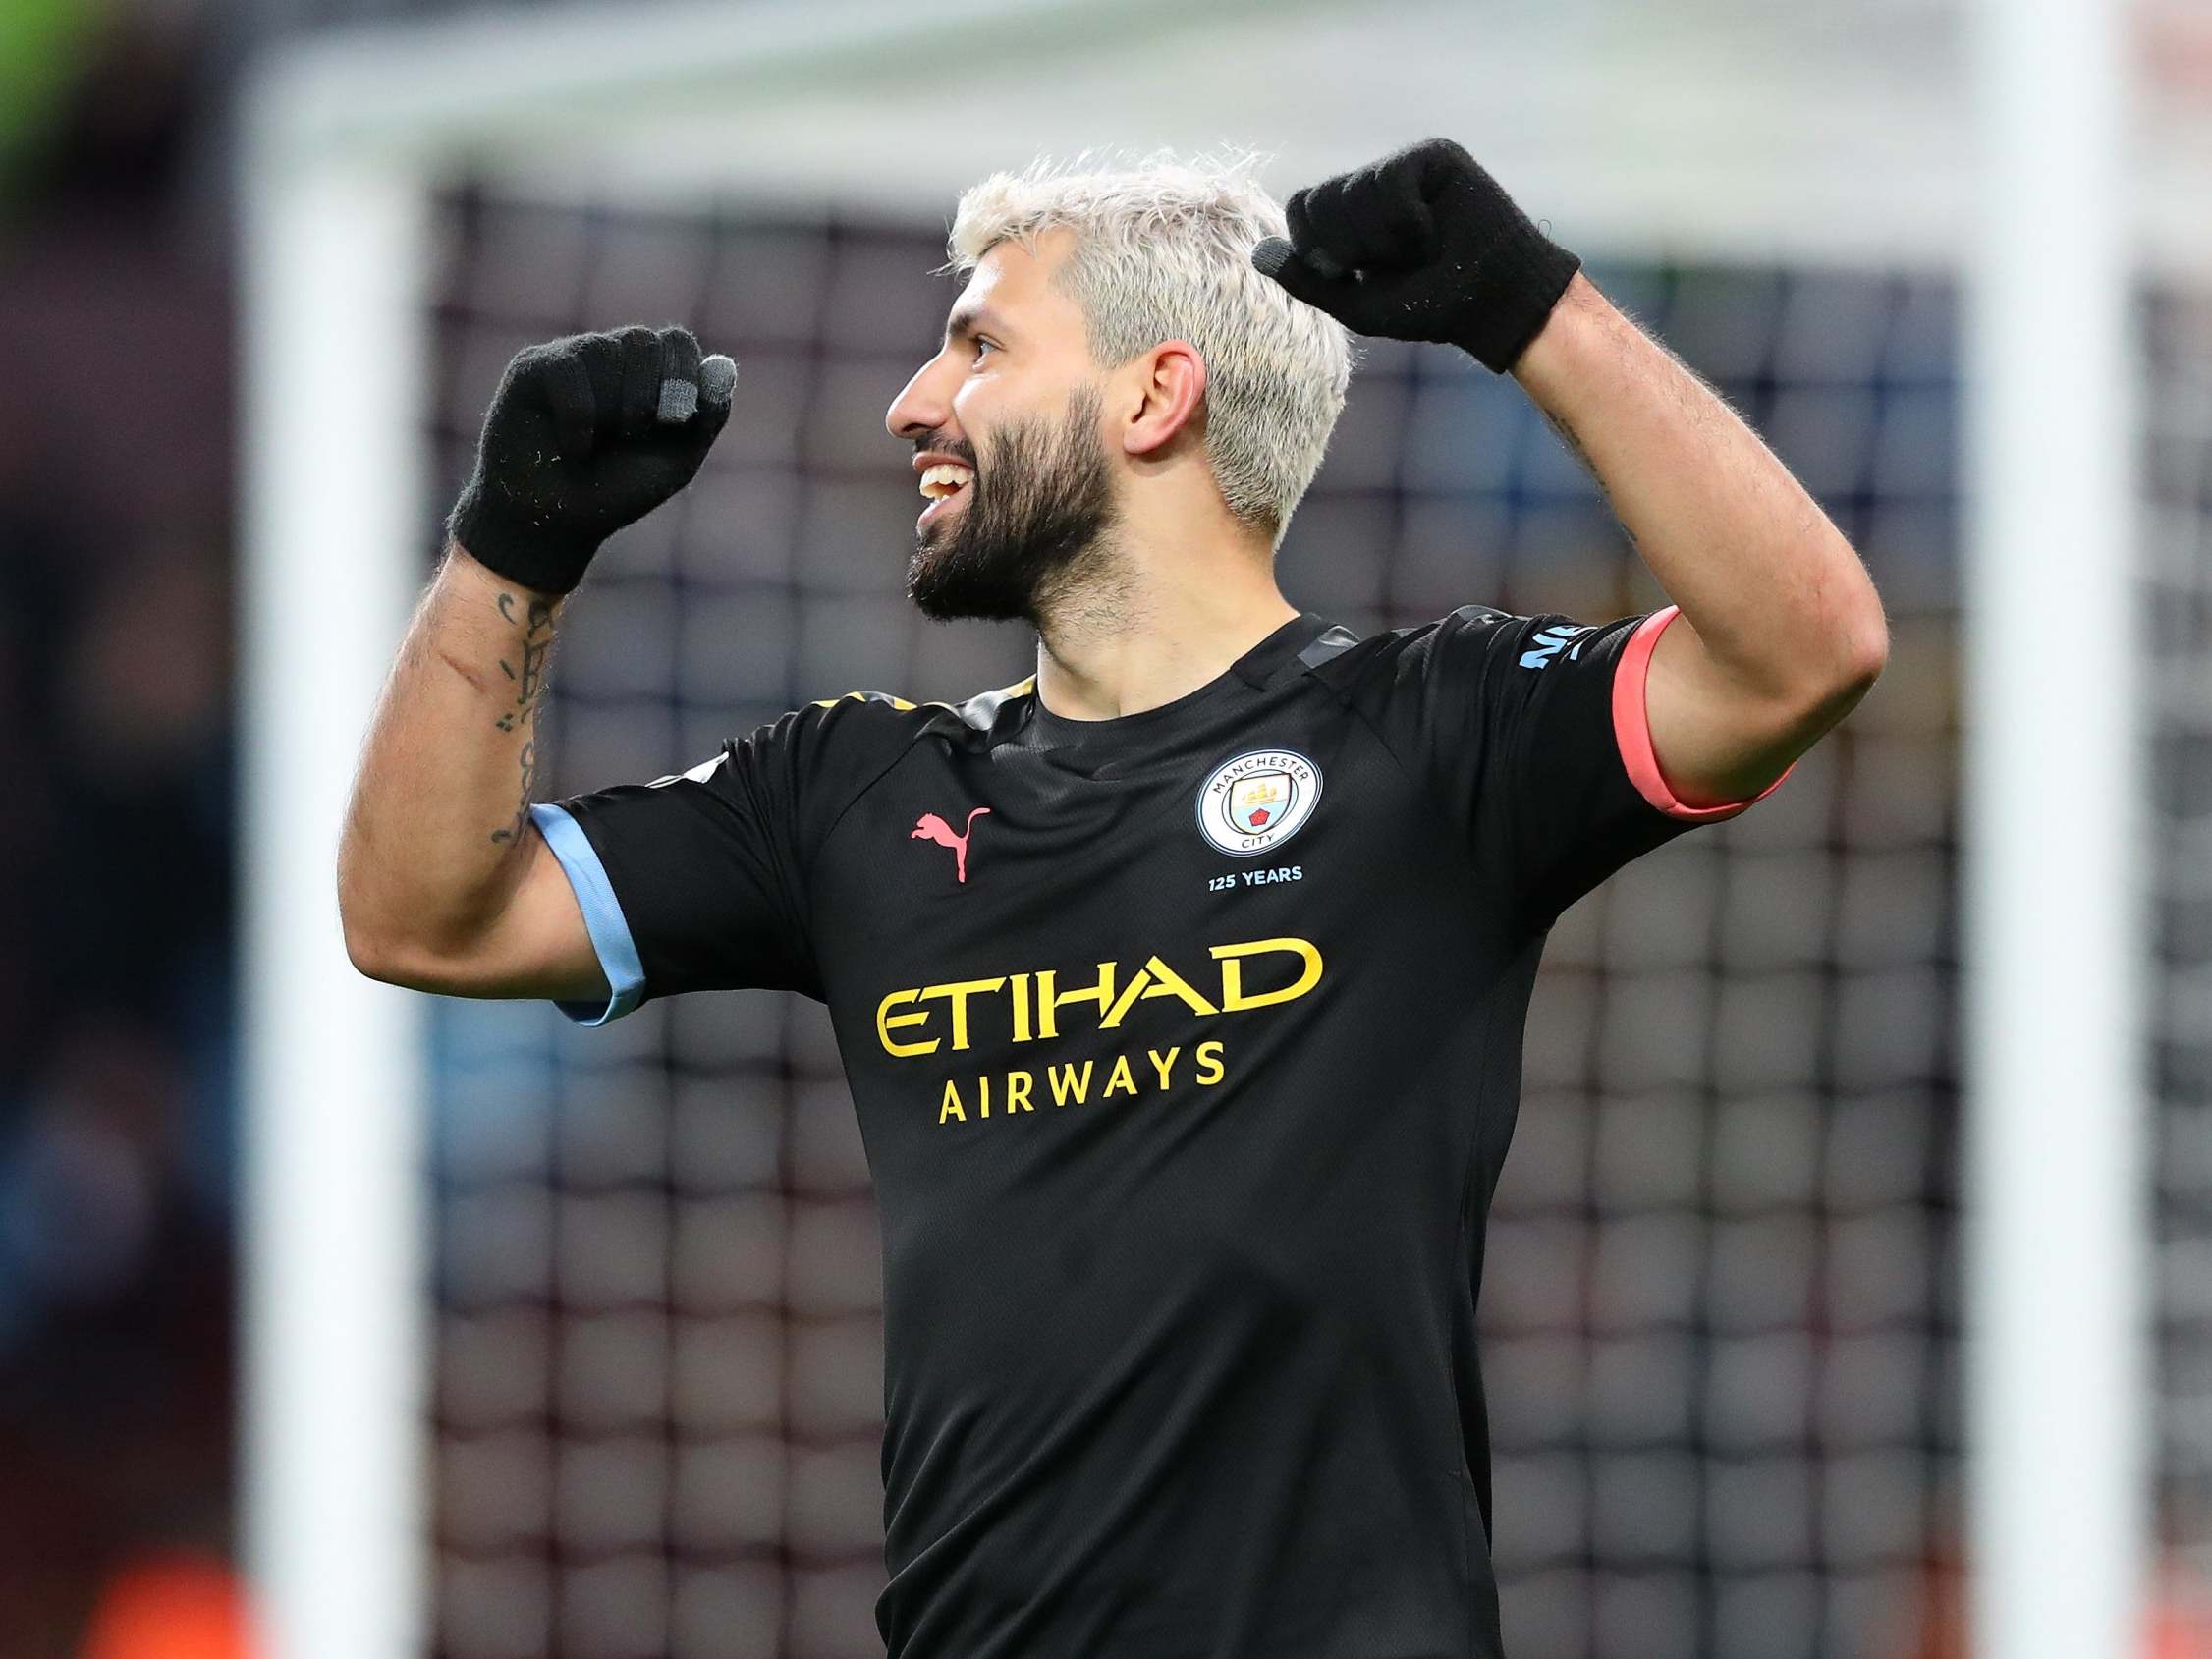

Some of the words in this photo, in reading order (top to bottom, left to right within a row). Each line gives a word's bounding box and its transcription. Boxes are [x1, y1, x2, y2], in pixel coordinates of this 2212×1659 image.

[1213, 756, 1309, 794] MANCHESTER
[1242, 834, 1275, 849] CITY
[1208, 875, 1236, 892] 125
[1242, 866, 1303, 886] YEARS
[876, 937, 1324, 1058] ETIHAD
[939, 1040, 1225, 1124] AIRWAYS
